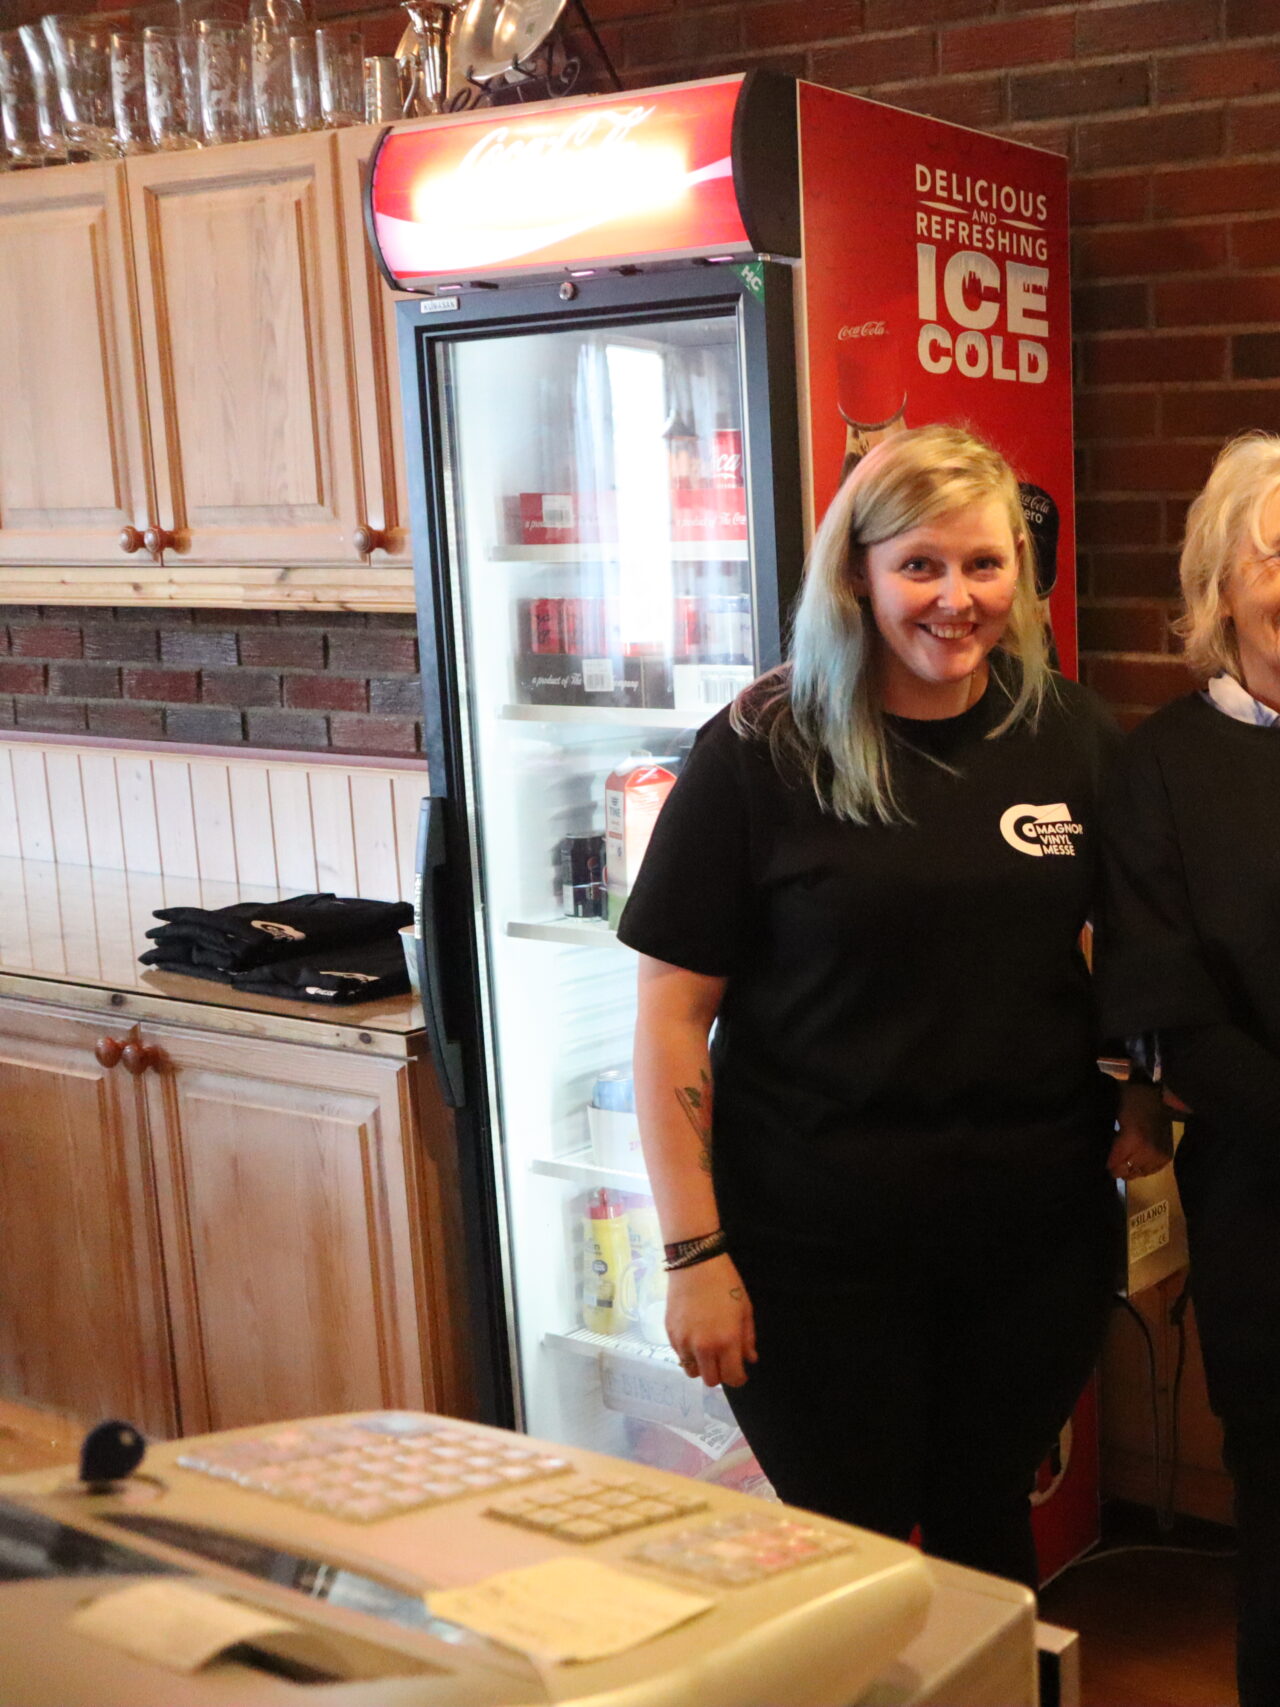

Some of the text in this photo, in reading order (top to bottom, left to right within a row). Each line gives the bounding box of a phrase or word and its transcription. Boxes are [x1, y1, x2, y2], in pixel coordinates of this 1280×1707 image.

[915, 163, 1048, 221] DELICIOUS
[971, 209, 997, 225] AND
[916, 212, 1048, 261] REFRESHING
[916, 242, 1049, 337] ICE
[917, 323, 1048, 384] COLD
[1024, 509, 1043, 524] ero
[1035, 823, 1083, 834] MAGNOR
[1040, 834, 1072, 845] VINYL
[1042, 845, 1075, 856] MESSE
